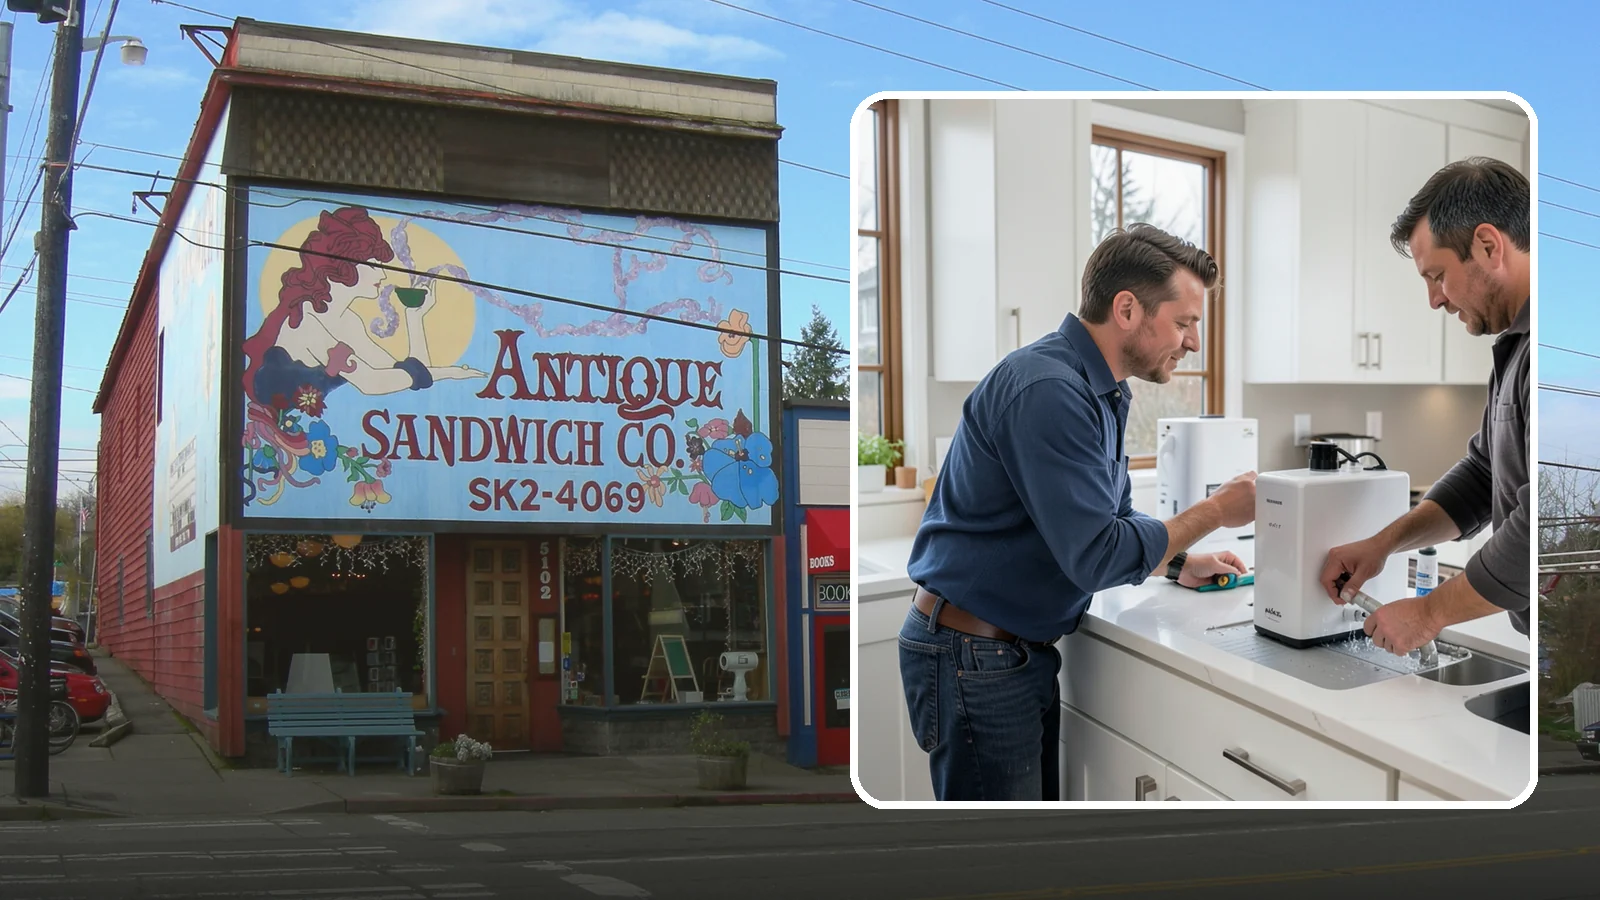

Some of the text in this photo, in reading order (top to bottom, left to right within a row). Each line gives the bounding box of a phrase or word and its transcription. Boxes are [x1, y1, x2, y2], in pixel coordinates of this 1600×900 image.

[475, 329, 724, 421] ANTIQUE
[361, 408, 686, 469] SANDWICH CO.
[468, 476, 646, 513] SK2-4069
[540, 541, 551, 600] 5102
[809, 555, 835, 569] BOOKS
